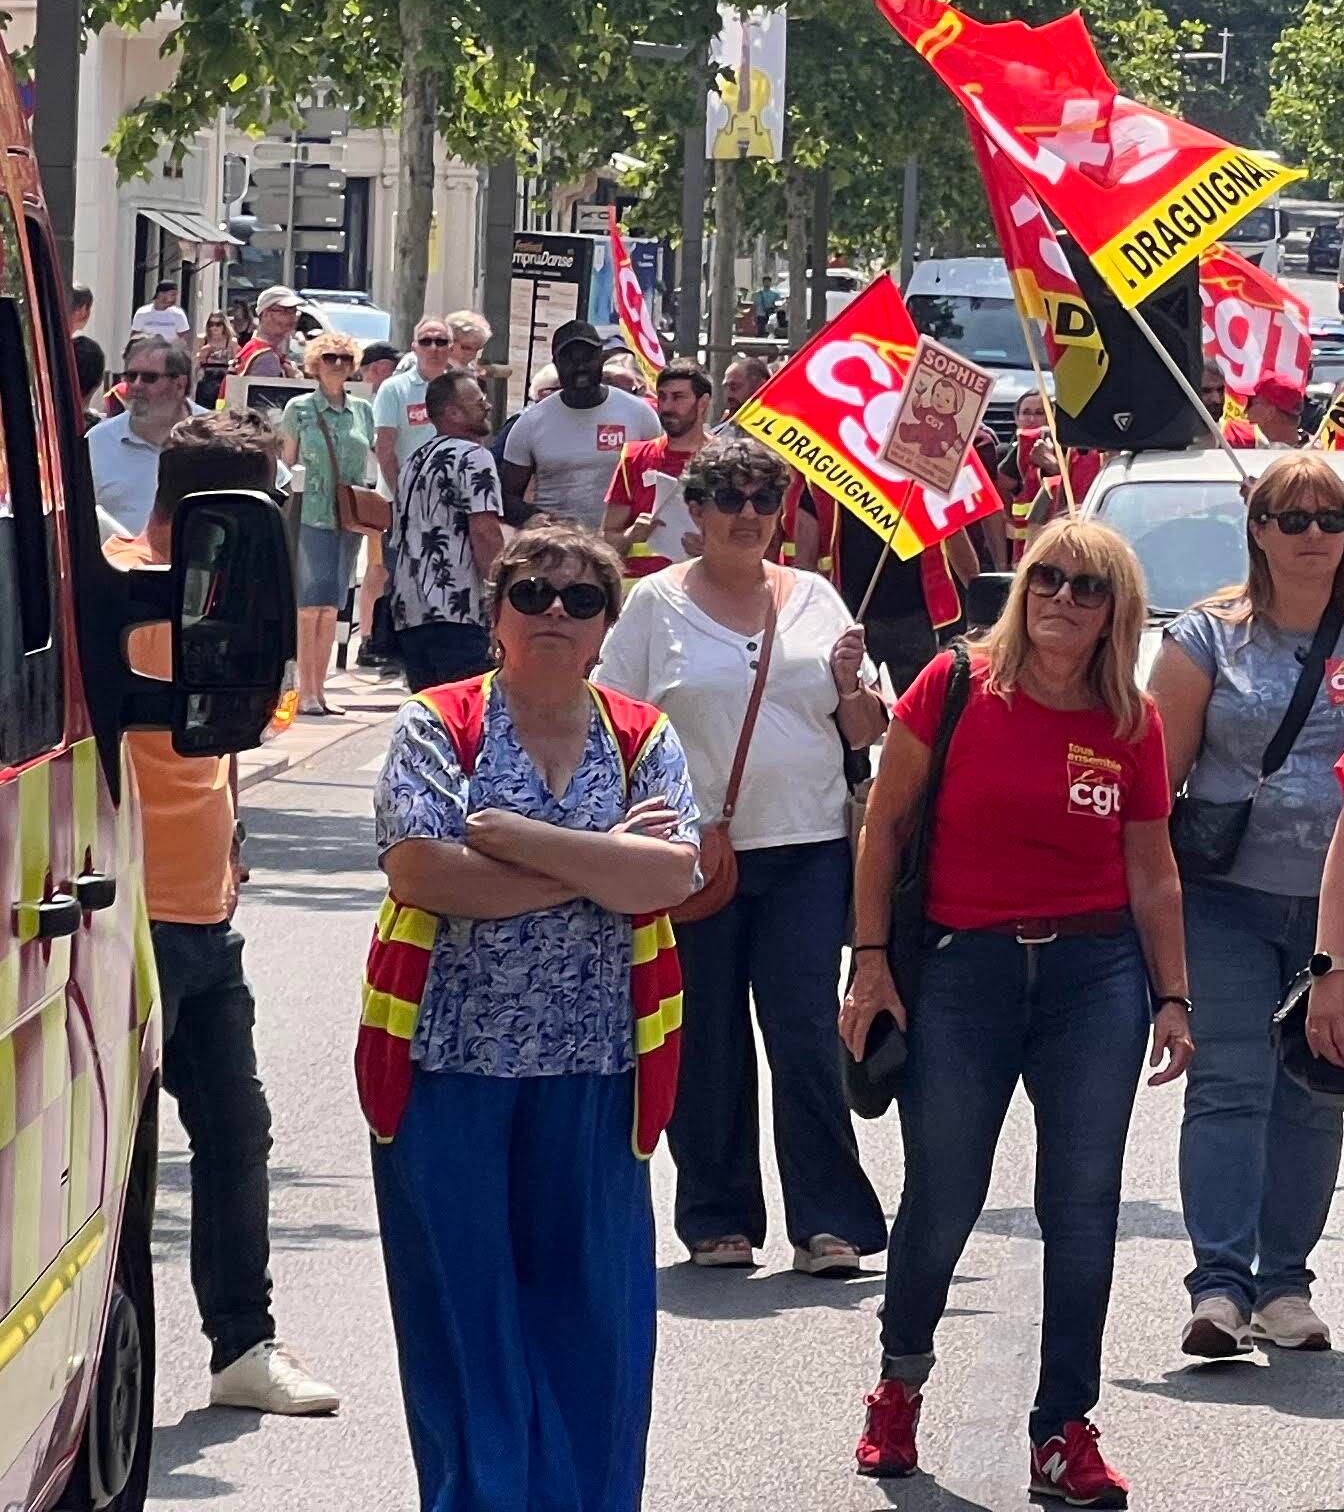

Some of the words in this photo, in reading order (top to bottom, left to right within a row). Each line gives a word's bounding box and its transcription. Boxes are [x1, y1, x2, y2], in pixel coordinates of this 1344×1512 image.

[512, 251, 573, 269] mpruDanse
[923, 349, 988, 394] SOPHIE
[599, 430, 625, 446] cgt
[777, 425, 899, 531] DRAGUIGNAN
[1069, 782, 1120, 816] cgt
